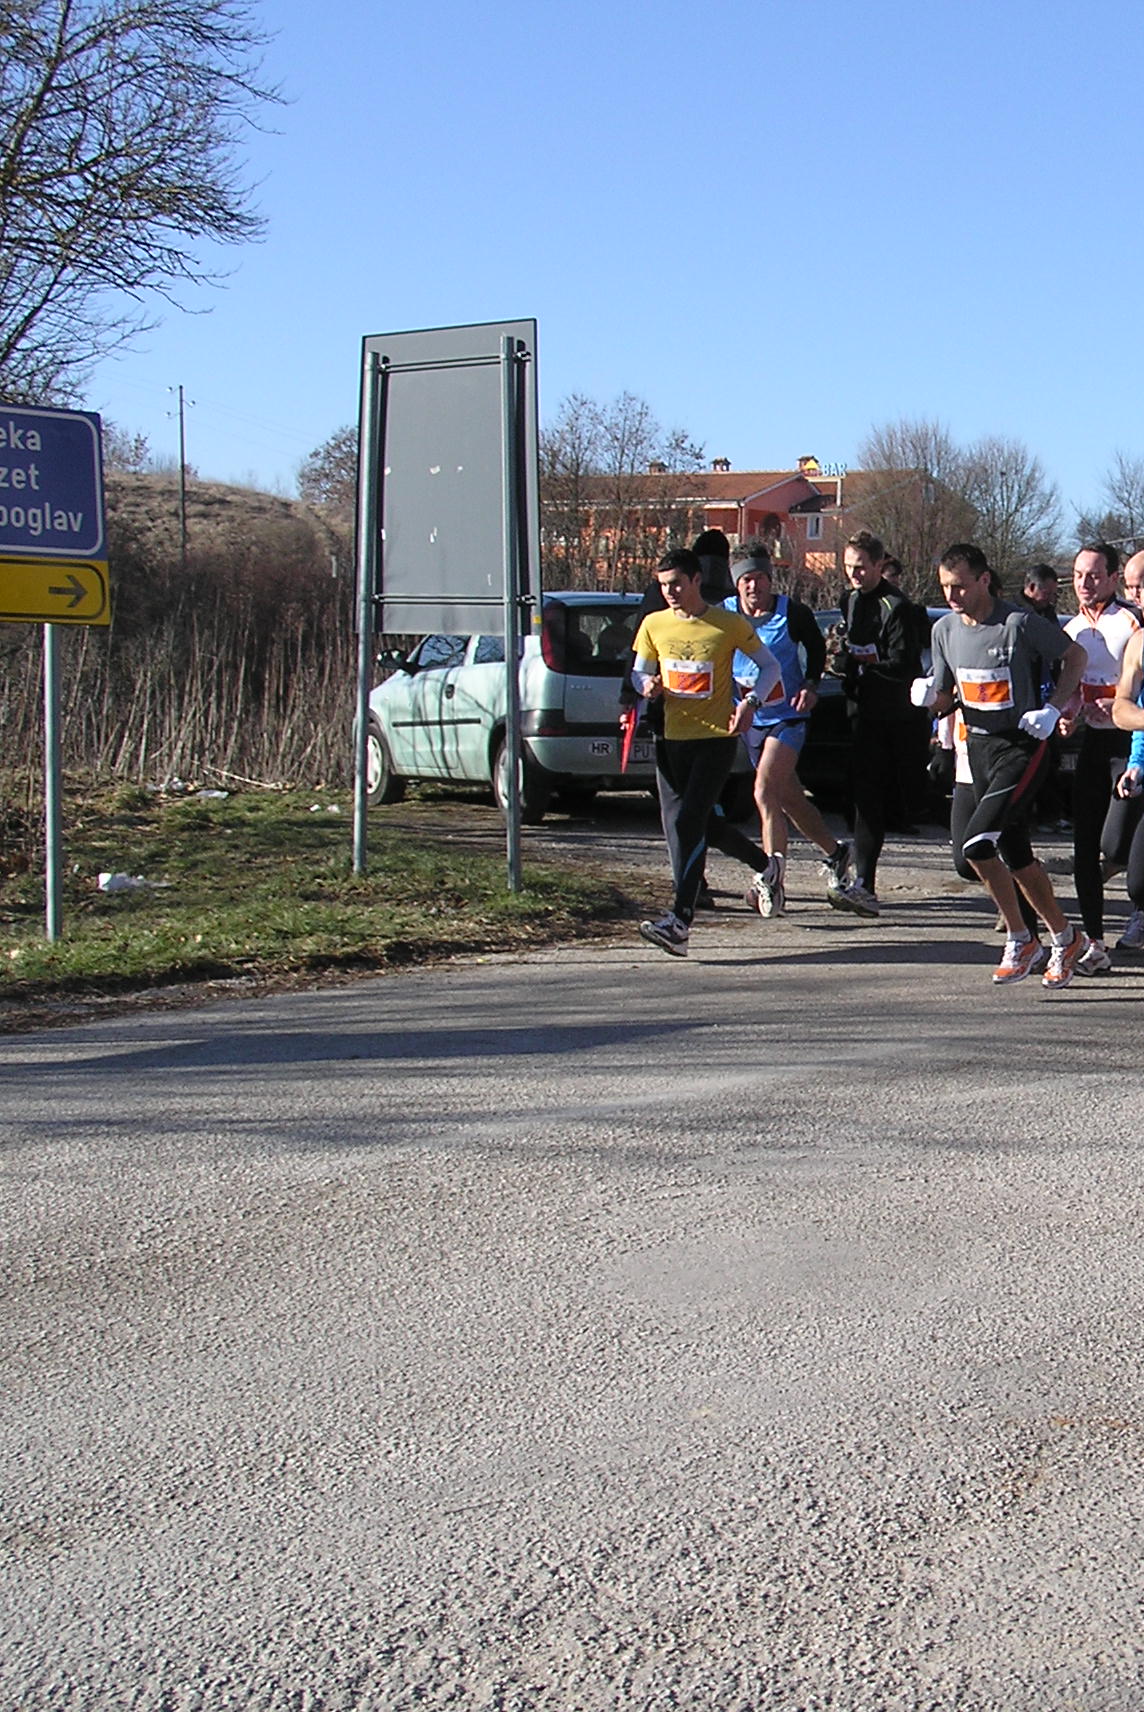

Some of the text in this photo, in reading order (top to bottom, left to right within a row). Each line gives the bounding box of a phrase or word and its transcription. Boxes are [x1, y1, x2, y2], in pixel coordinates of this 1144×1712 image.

[822, 463, 847, 478] BAR
[591, 743, 610, 754] HR
[633, 745, 650, 758] PU
